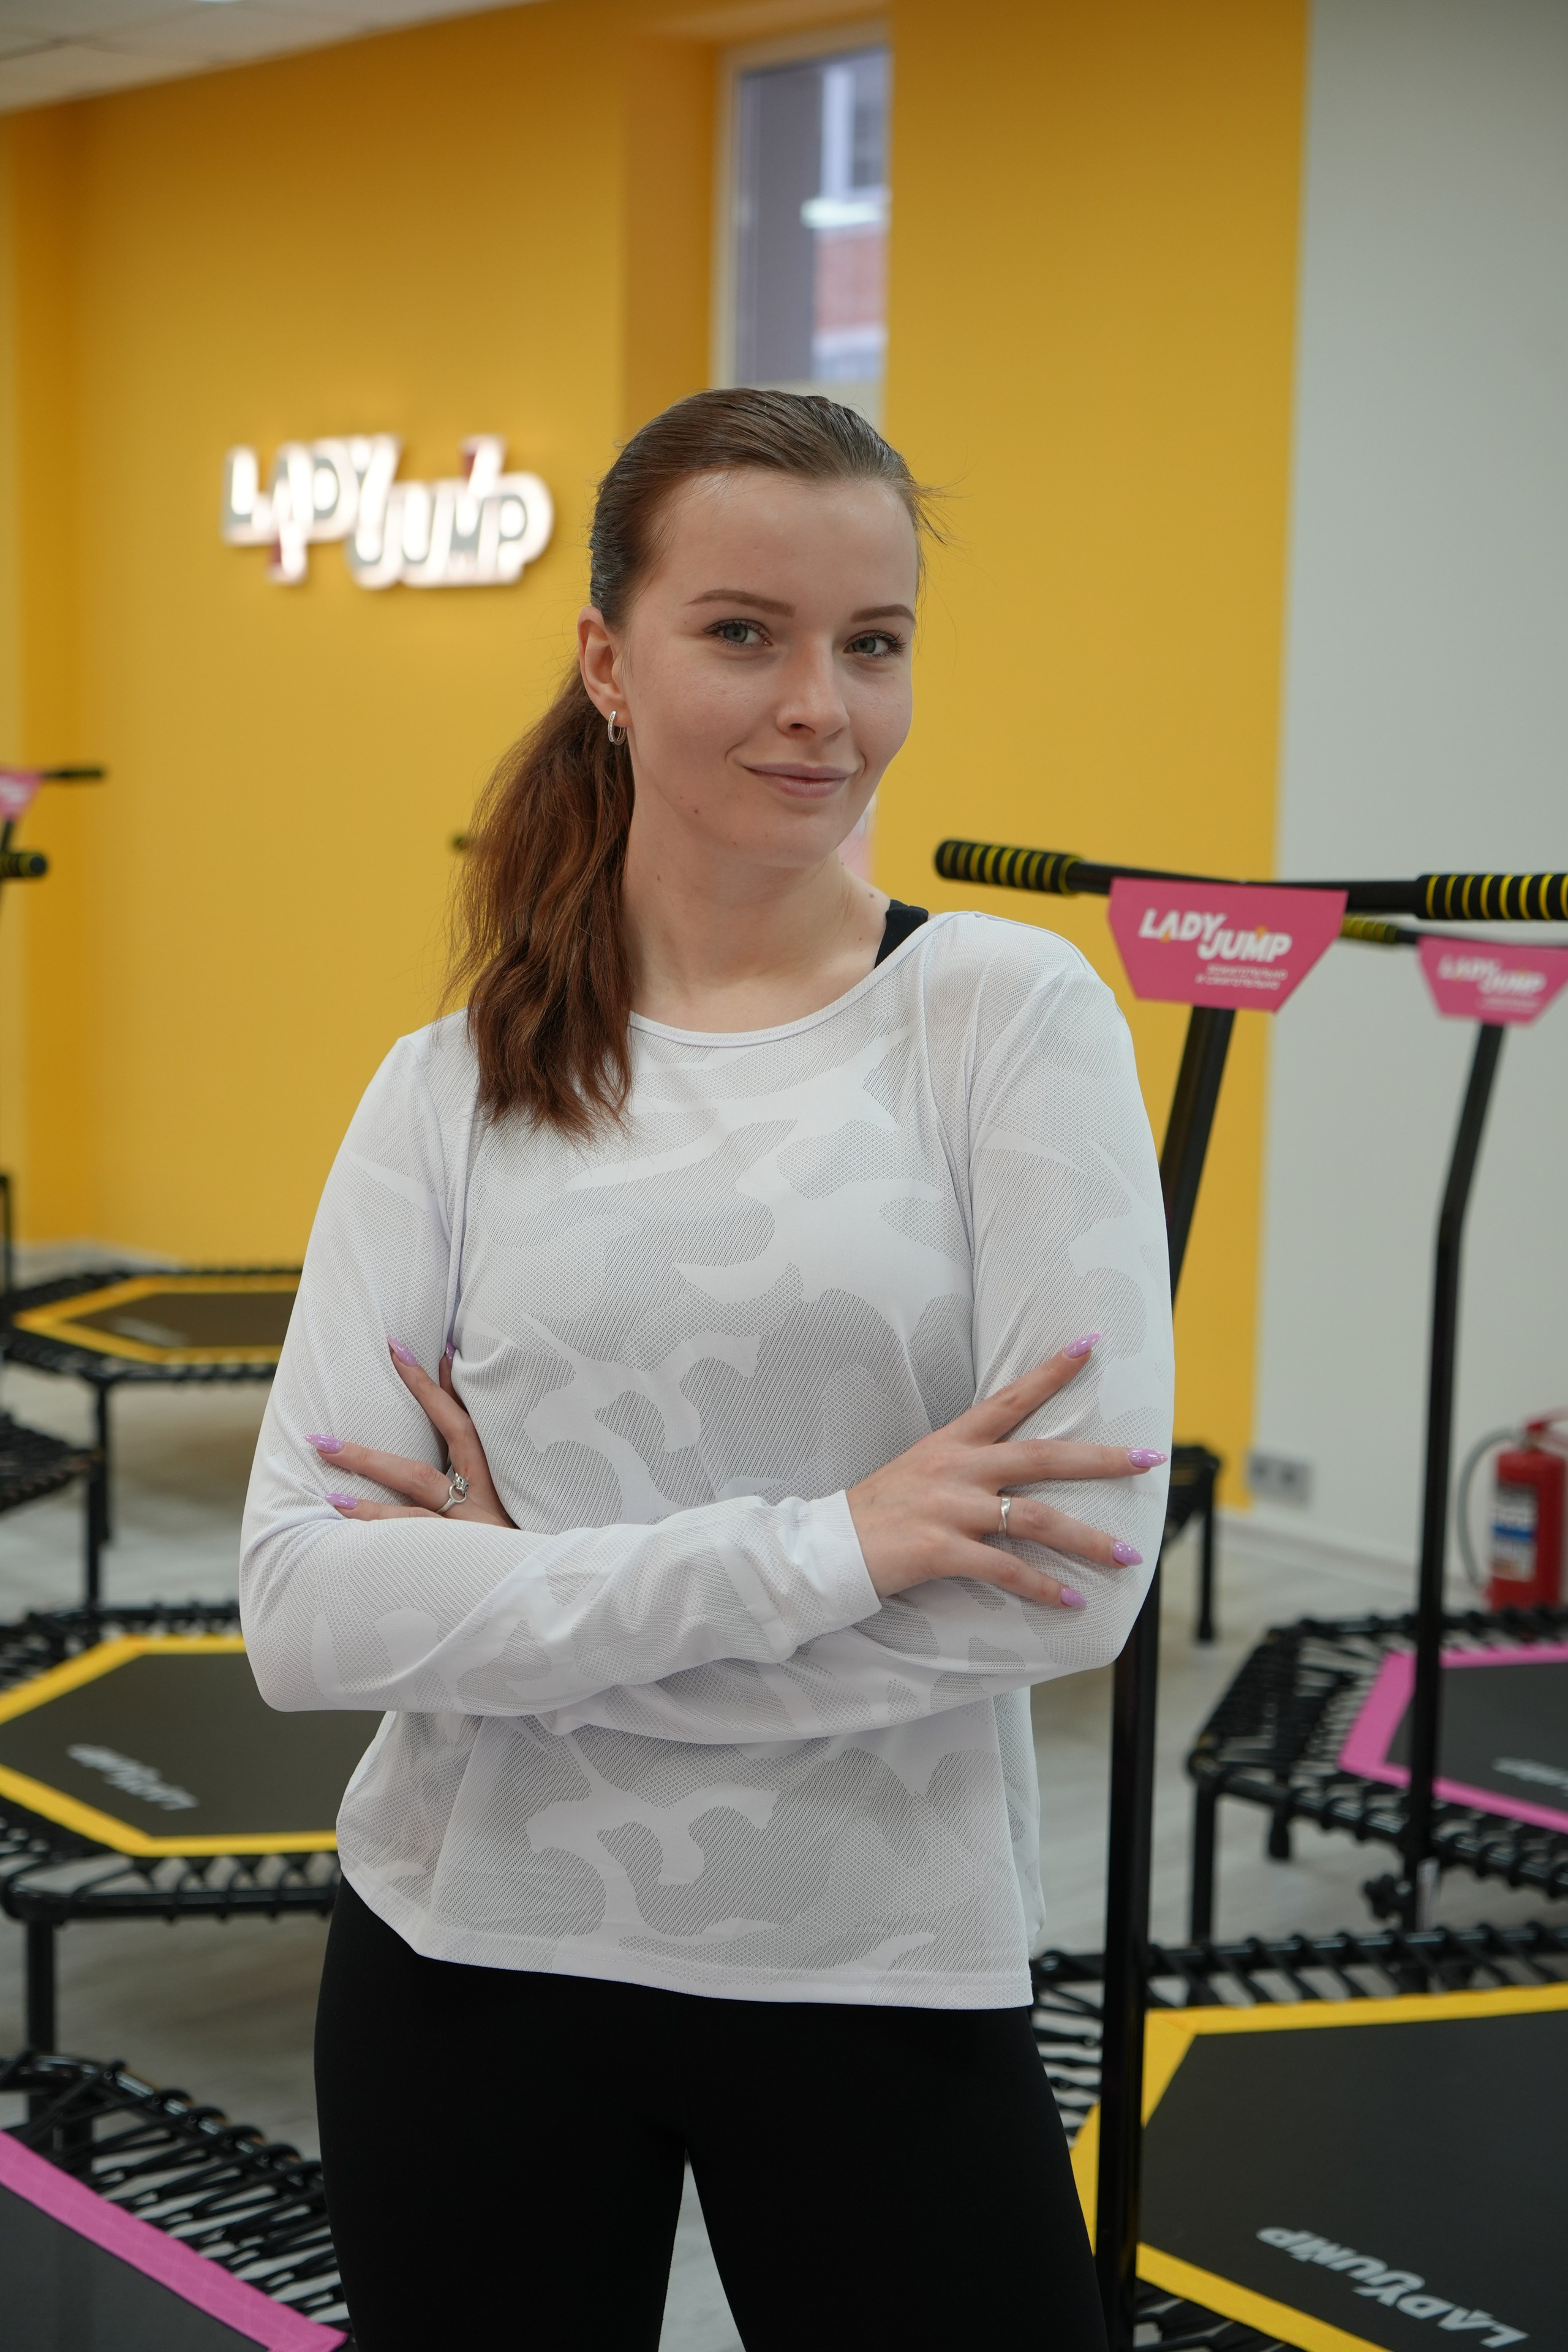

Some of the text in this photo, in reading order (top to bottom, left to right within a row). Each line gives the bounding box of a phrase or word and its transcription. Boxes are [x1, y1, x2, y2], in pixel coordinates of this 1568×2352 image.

[222, 436, 402, 546] LADY
[345, 477, 552, 589] JUMP
[1139, 908, 1227, 943] LADY
[1197, 926, 1292, 962] JUMP
[1255, 2226, 1425, 2292] JUMP
[1351, 2285, 1530, 2348] LADY
